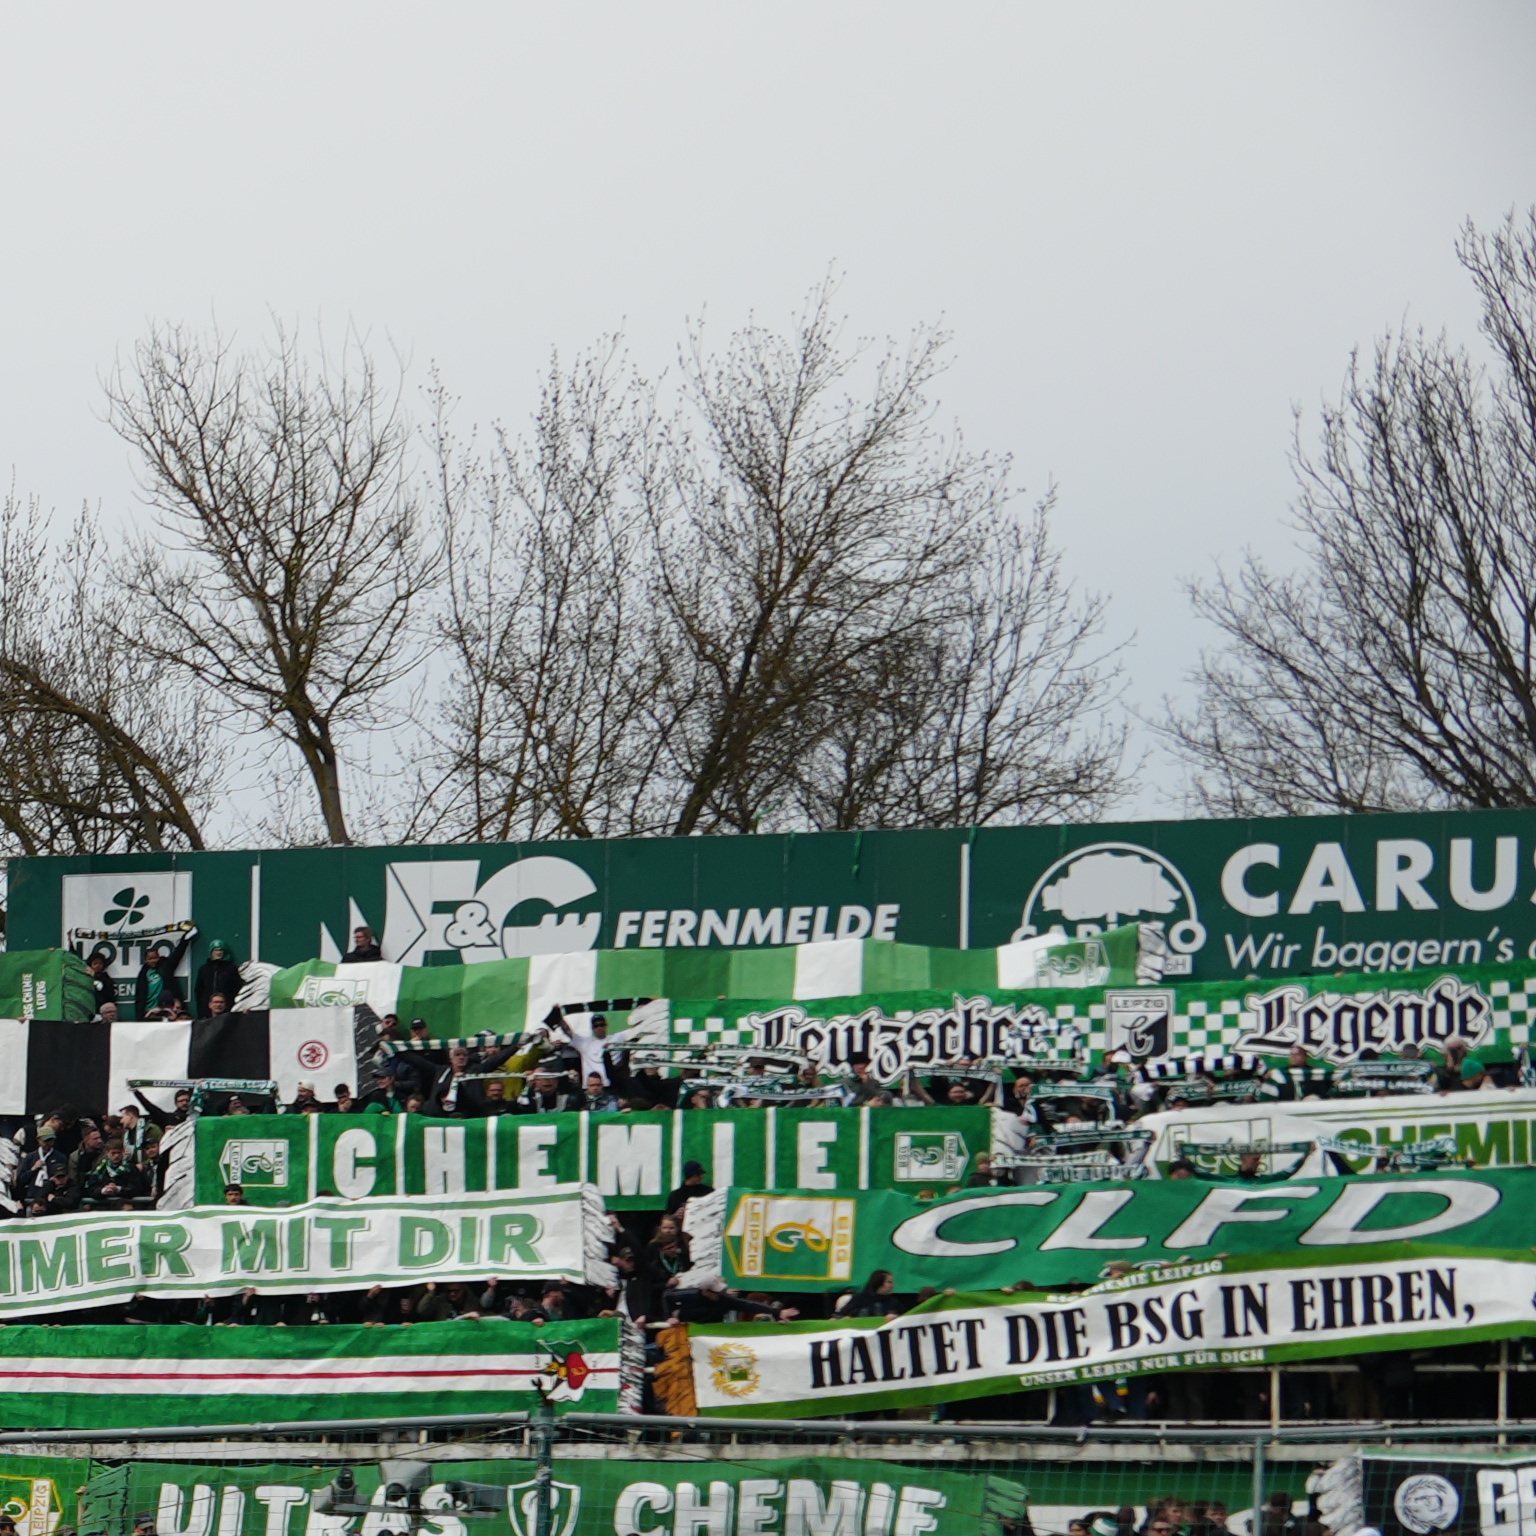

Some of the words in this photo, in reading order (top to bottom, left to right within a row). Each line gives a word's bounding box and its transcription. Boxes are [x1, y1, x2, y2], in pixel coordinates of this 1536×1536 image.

[1221, 836, 1536, 917] CARU
[613, 904, 900, 948] FERNMELDE
[1225, 933, 1301, 969] Wir
[1232, 974, 1493, 1064] Legende
[333, 1118, 838, 1199] CHEMIE
[1335, 1120, 1536, 1170] CHEMI
[221, 1216, 372, 1275] MIT
[398, 1212, 546, 1269] DIR
[891, 1178, 1504, 1258] CLFD
[809, 1318, 986, 1390] HALTET
[1006, 1307, 1090, 1364] DIE
[1105, 1290, 1204, 1351] BSG
[1219, 1282, 1270, 1338] IN
[1289, 1267, 1476, 1333] EHREN,
[1082, 1359, 1138, 1379] LEBEN
[1141, 1355, 1179, 1370] NUR
[1221, 1348, 1265, 1362] DICH
